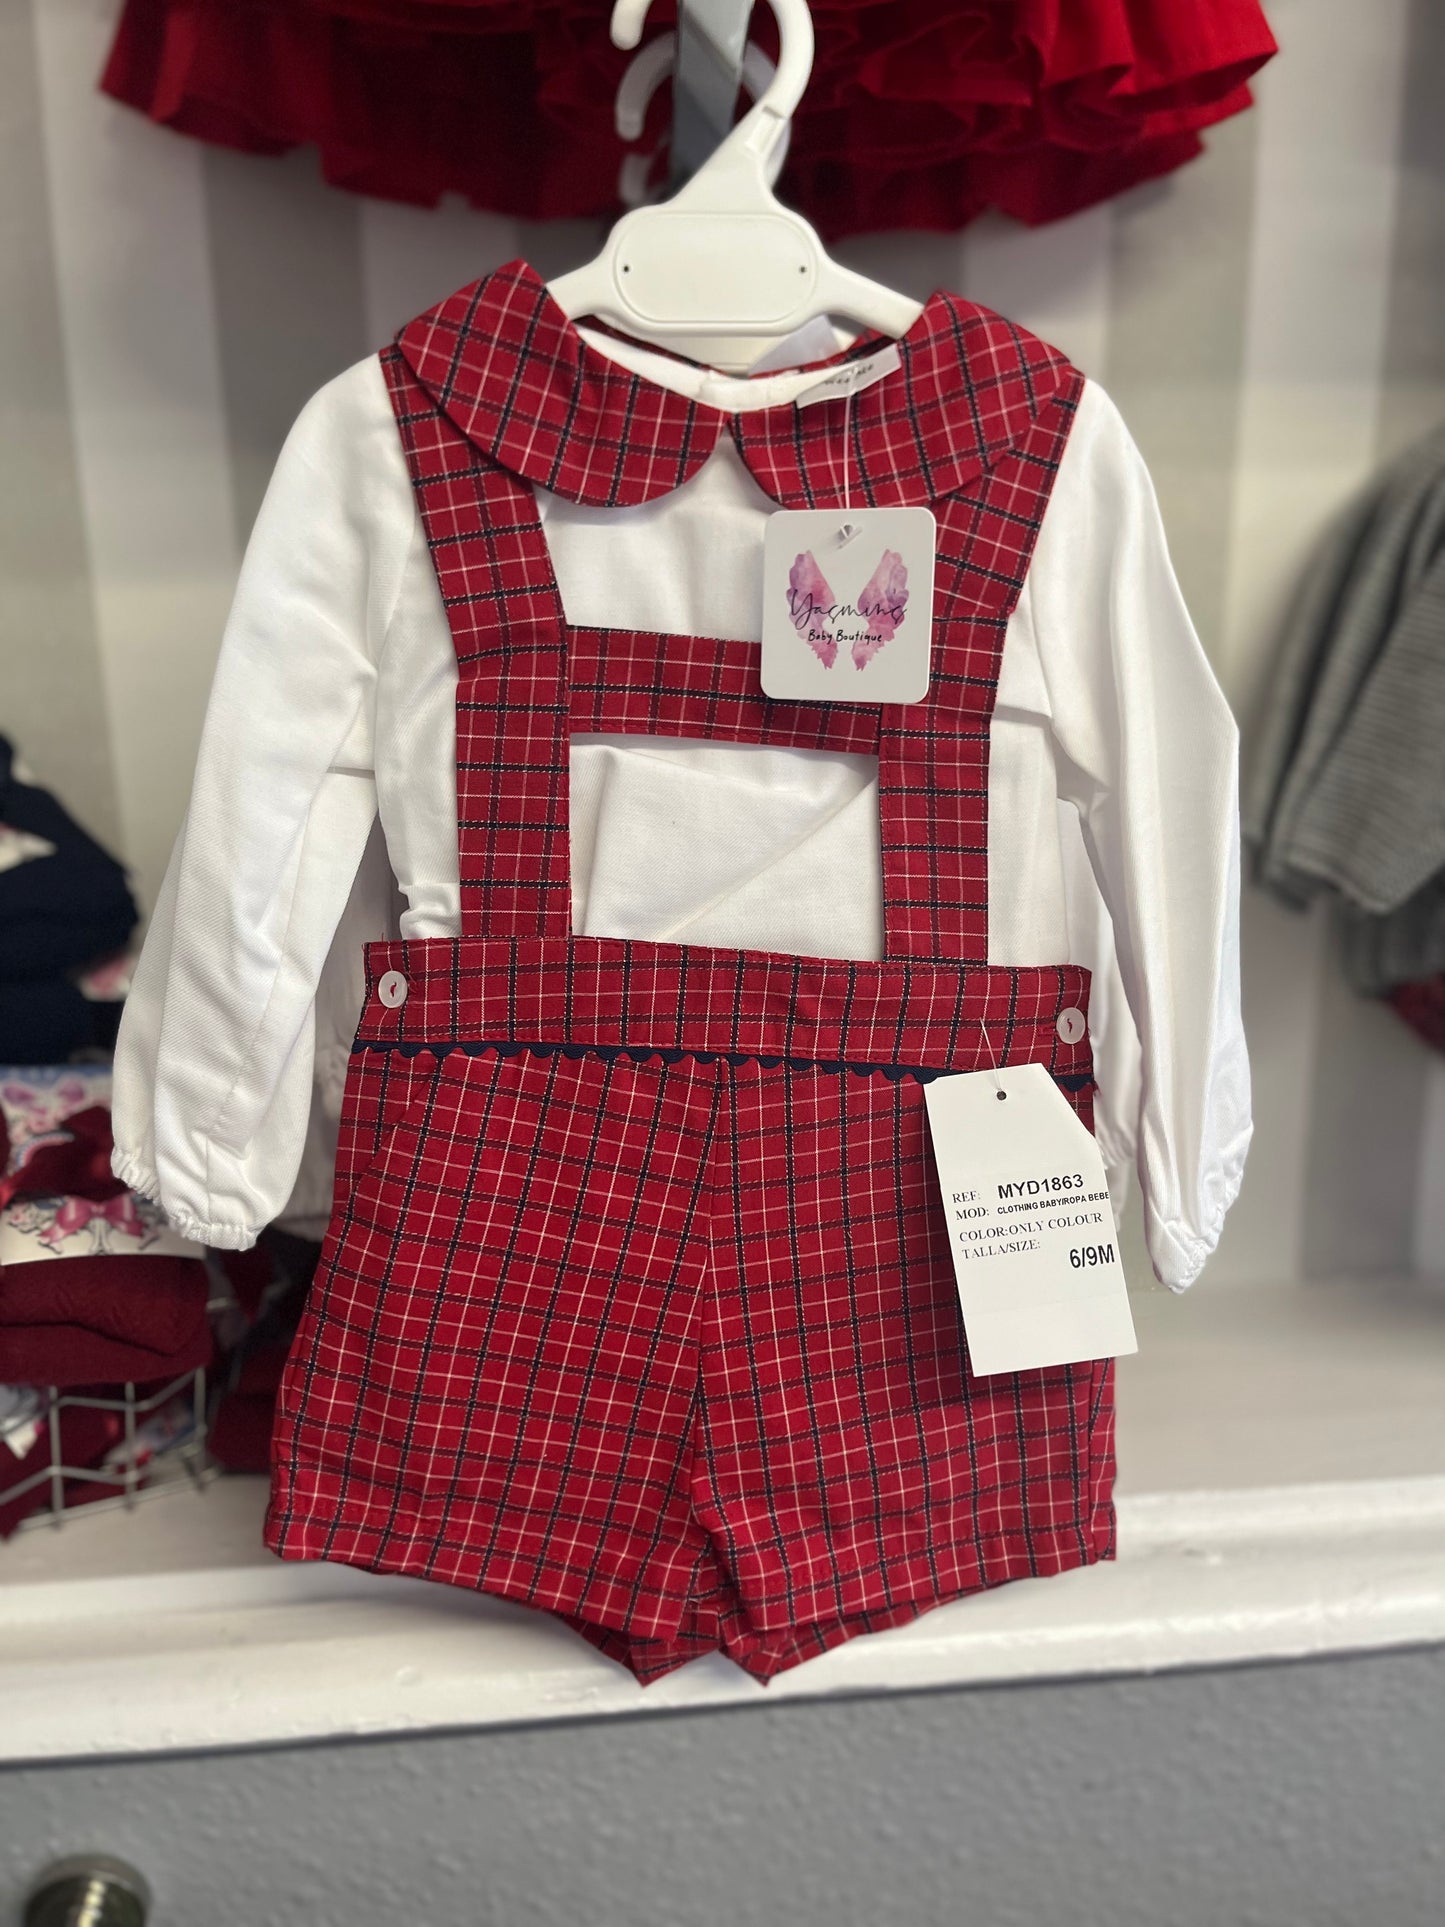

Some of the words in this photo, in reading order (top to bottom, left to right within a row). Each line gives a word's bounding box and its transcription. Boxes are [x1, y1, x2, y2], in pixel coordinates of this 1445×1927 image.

[790, 589, 907, 631] Yasmins
[808, 629, 833, 644] Baby
[836, 629, 882, 643] Boutique
[952, 1190, 981, 1204] REF:
[997, 1173, 1084, 1199] MYD1863
[956, 1206, 990, 1221] MOD:
[997, 1202, 1039, 1215] CLOTHING
[1088, 1191, 1110, 1202] BEBE
[1047, 1212, 1103, 1230] COLOUR
[961, 1239, 1041, 1260] TALLA/SIZE:
[1069, 1243, 1115, 1269] 6/9M
